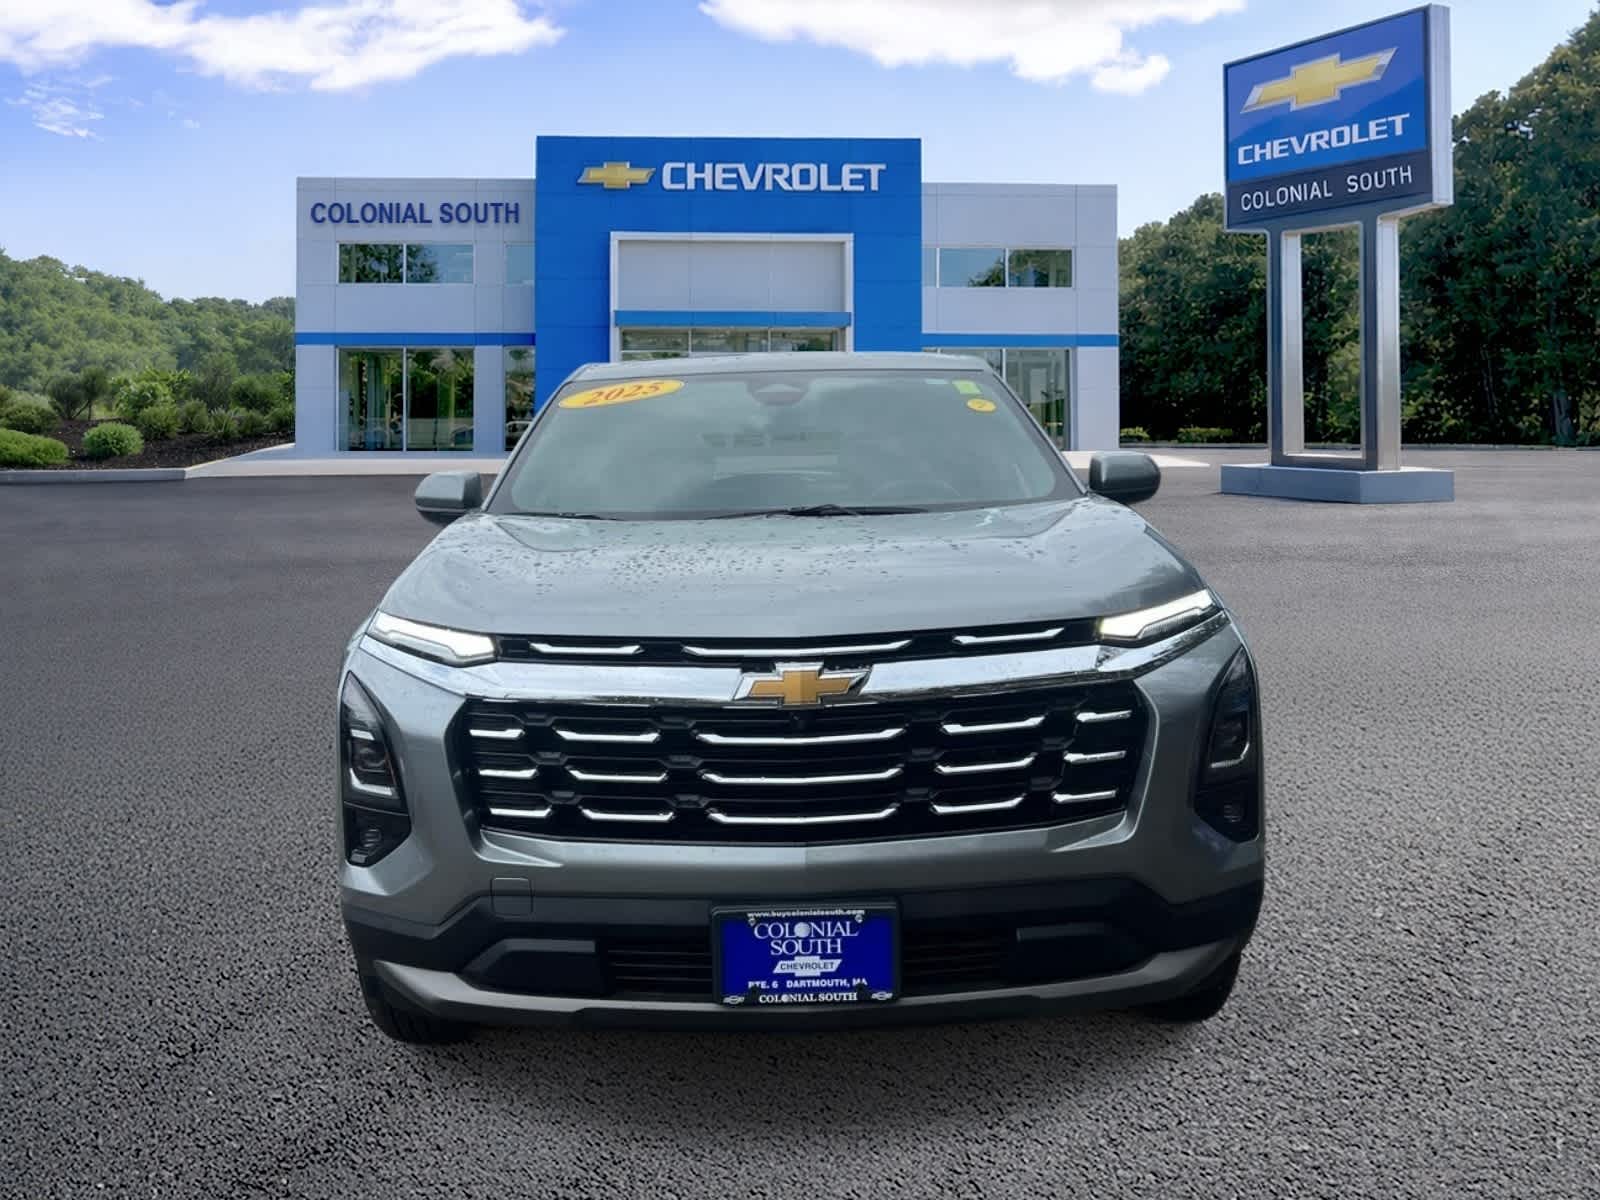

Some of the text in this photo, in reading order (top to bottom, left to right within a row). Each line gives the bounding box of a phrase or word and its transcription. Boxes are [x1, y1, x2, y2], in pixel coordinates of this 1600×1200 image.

[1237, 113, 1410, 165] CHEVROLET
[662, 162, 886, 192] CHEVROLET
[1240, 165, 1412, 211] COLONIAL SOUTH
[310, 202, 520, 224] COLONIAL SOUTH
[584, 381, 664, 405] 2025
[754, 921, 859, 939] COLONIAL
[770, 938, 843, 956] SOUTH
[780, 961, 835, 971] CHEVROLET
[772, 980, 779, 989] 6
[786, 978, 850, 988] DARTMOUTH,
[759, 992, 858, 1003] COLONIAL SOUTH
